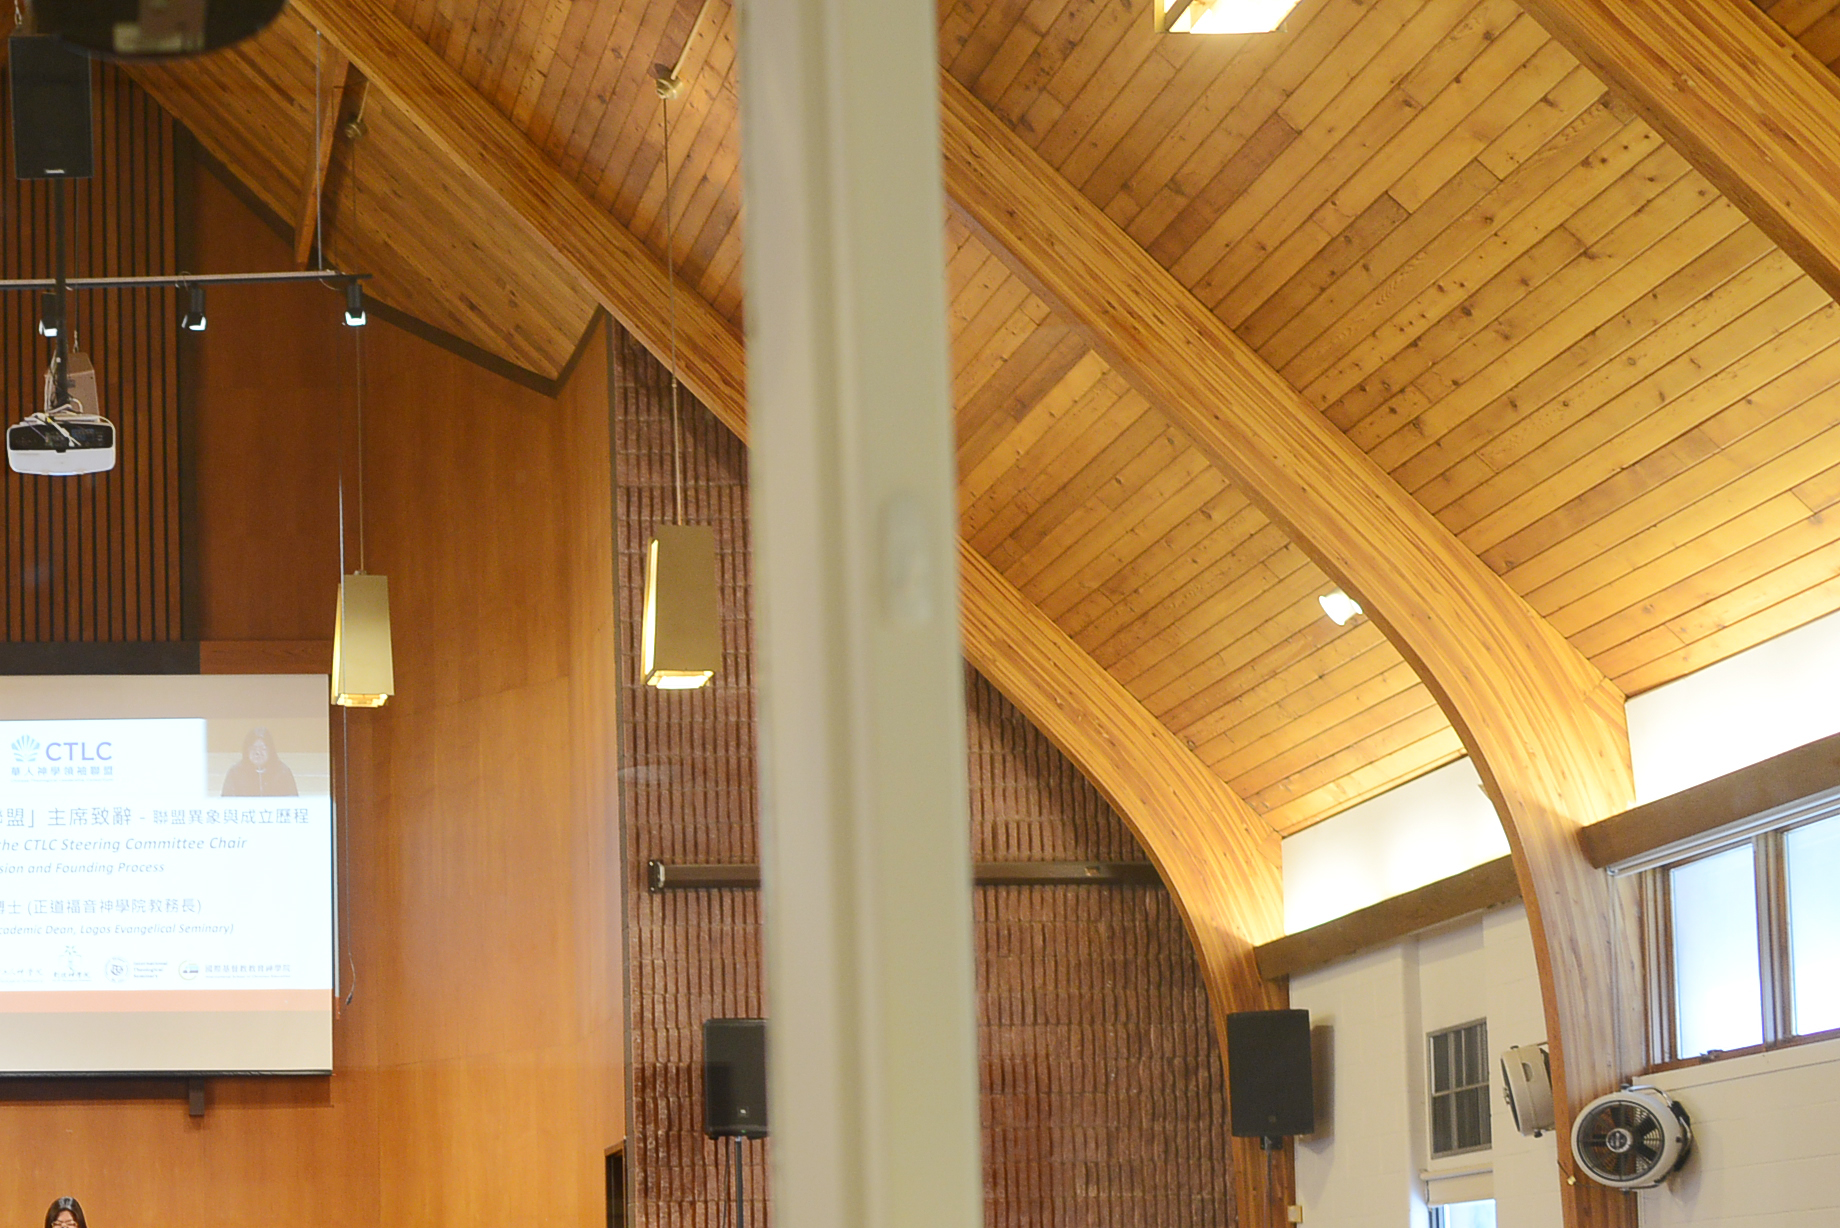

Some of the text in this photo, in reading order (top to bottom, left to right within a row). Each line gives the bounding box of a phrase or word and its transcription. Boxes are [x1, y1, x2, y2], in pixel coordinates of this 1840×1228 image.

[45, 741, 113, 761] CTLC
[47, 806, 132, 827] 主席致辭
[23, 838, 58, 851] CTLC
[60, 838, 121, 853] Steering
[125, 837, 205, 850] Committee
[209, 836, 248, 849] Chair
[27, 862, 53, 874] and
[55, 861, 114, 876] Founding
[117, 862, 165, 873] Process
[45, 925, 77, 937] Dean,
[80, 925, 111, 937] Logos
[114, 923, 176, 937] Evangelical
[178, 923, 234, 937] Seminary)
